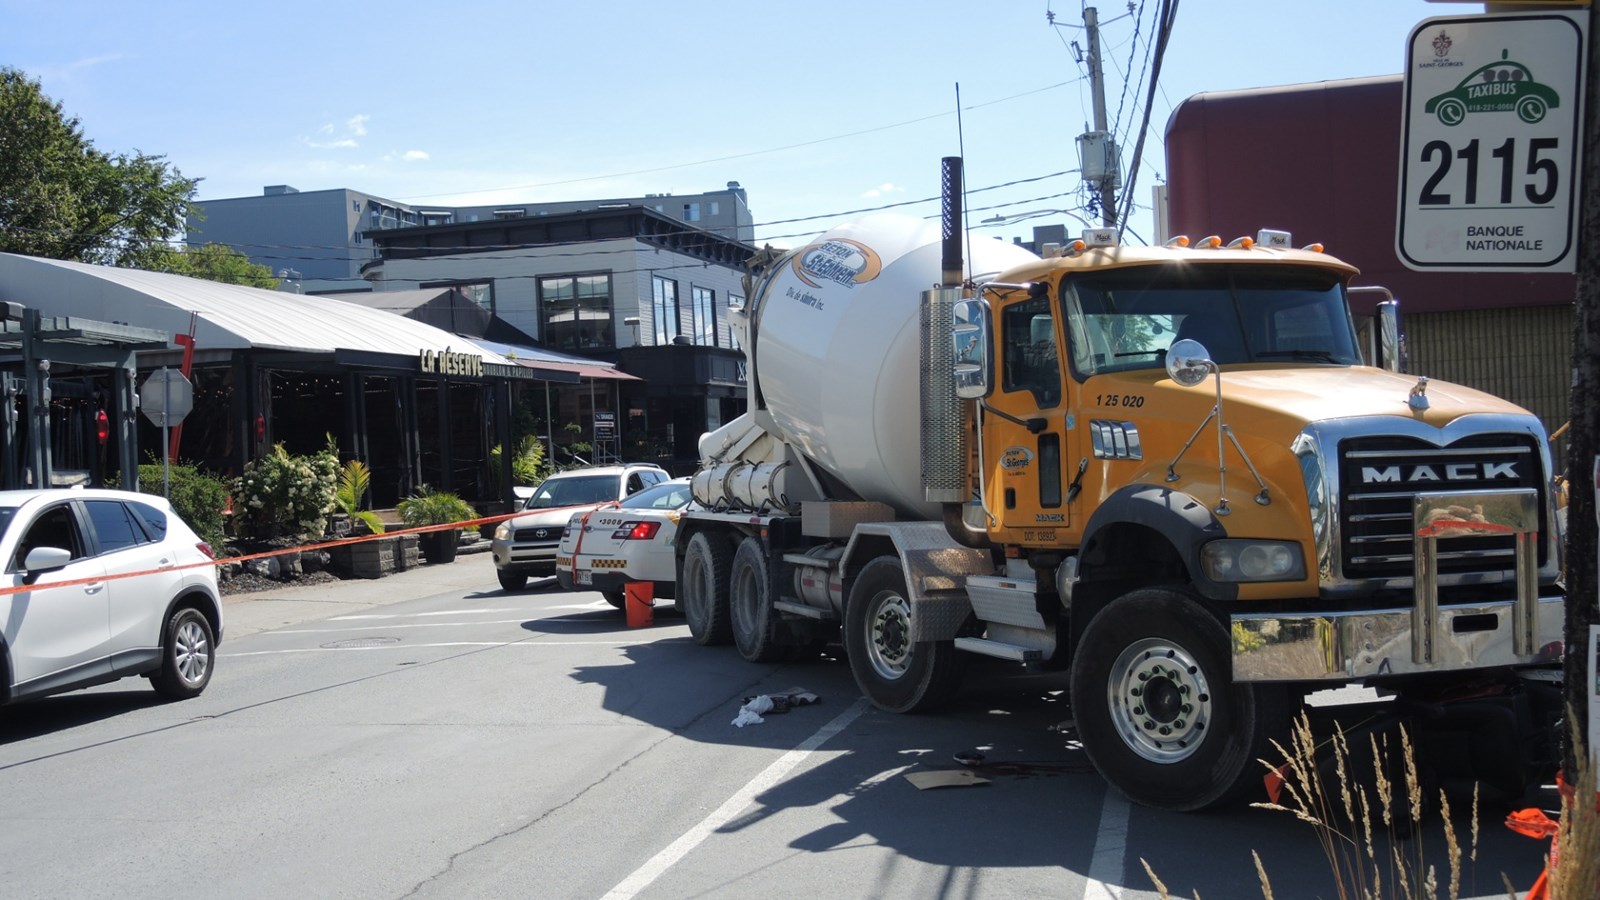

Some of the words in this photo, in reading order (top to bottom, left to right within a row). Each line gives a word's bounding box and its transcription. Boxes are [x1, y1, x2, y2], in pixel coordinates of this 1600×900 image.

[1468, 83, 1516, 99] TAXIBUS
[1418, 137, 1559, 206] 2115
[1095, 234, 1112, 242] Mack
[1467, 226, 1524, 237] BANQUE
[1466, 240, 1543, 251] NATIONALE
[420, 348, 435, 373] LA
[438, 345, 484, 377] RÉSERVE
[1096, 394, 1102, 406] 1
[1105, 394, 1119, 406] 25
[1122, 395, 1145, 408] 020
[1361, 462, 1520, 483] MACK
[1035, 514, 1065, 522] MACK
